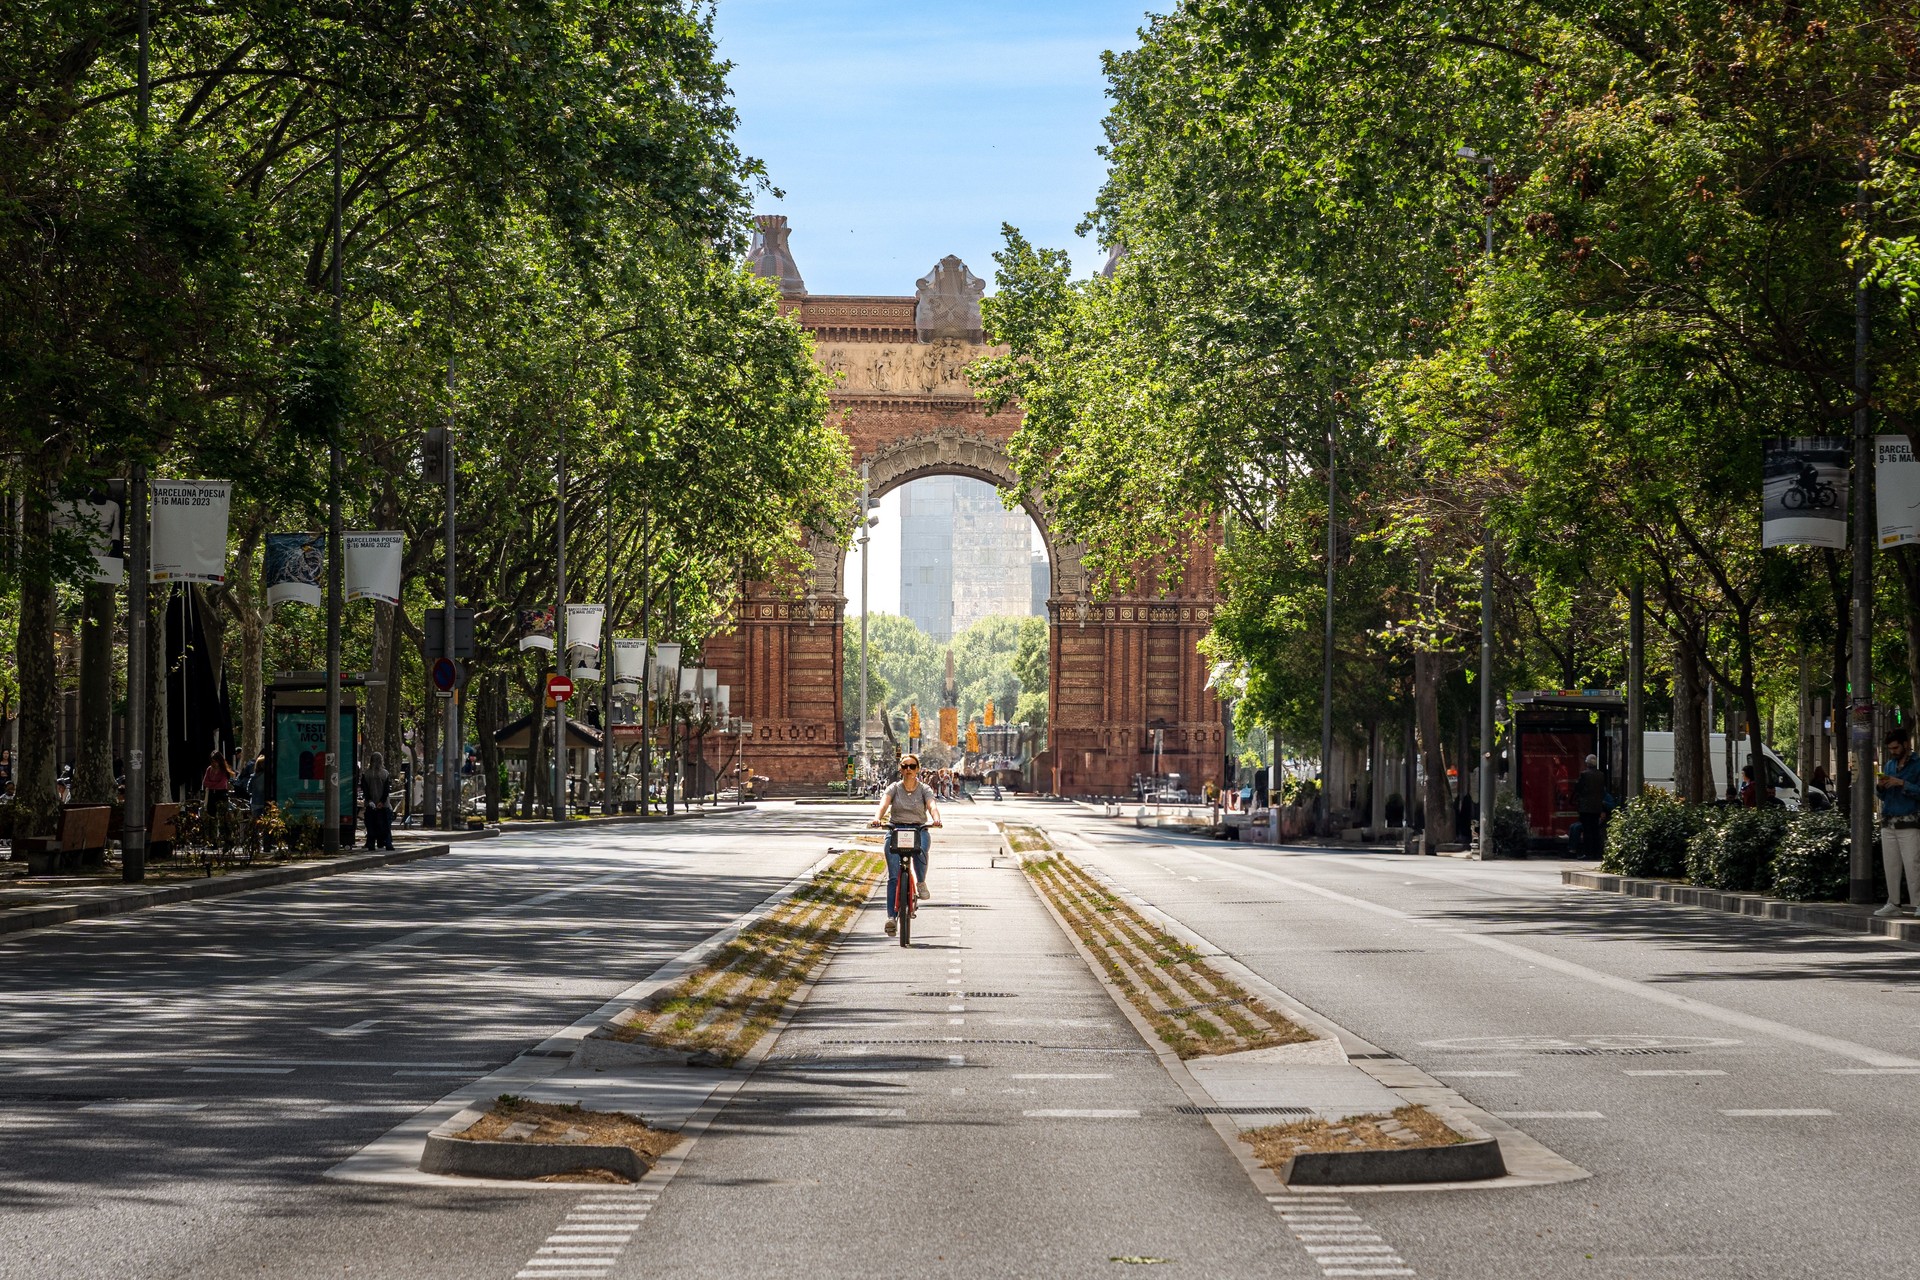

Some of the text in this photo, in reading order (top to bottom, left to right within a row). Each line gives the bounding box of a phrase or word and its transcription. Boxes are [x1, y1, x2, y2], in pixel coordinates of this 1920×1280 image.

[1879, 445, 1911, 454] BARCEL
[1879, 454, 1897, 463] 9-16
[153, 488, 225, 498] BARCELONA POESIA
[153, 497, 211, 506] 9-16 MAIG 2023
[296, 723, 326, 733] T'ESTI
[300, 733, 327, 742] MOL
